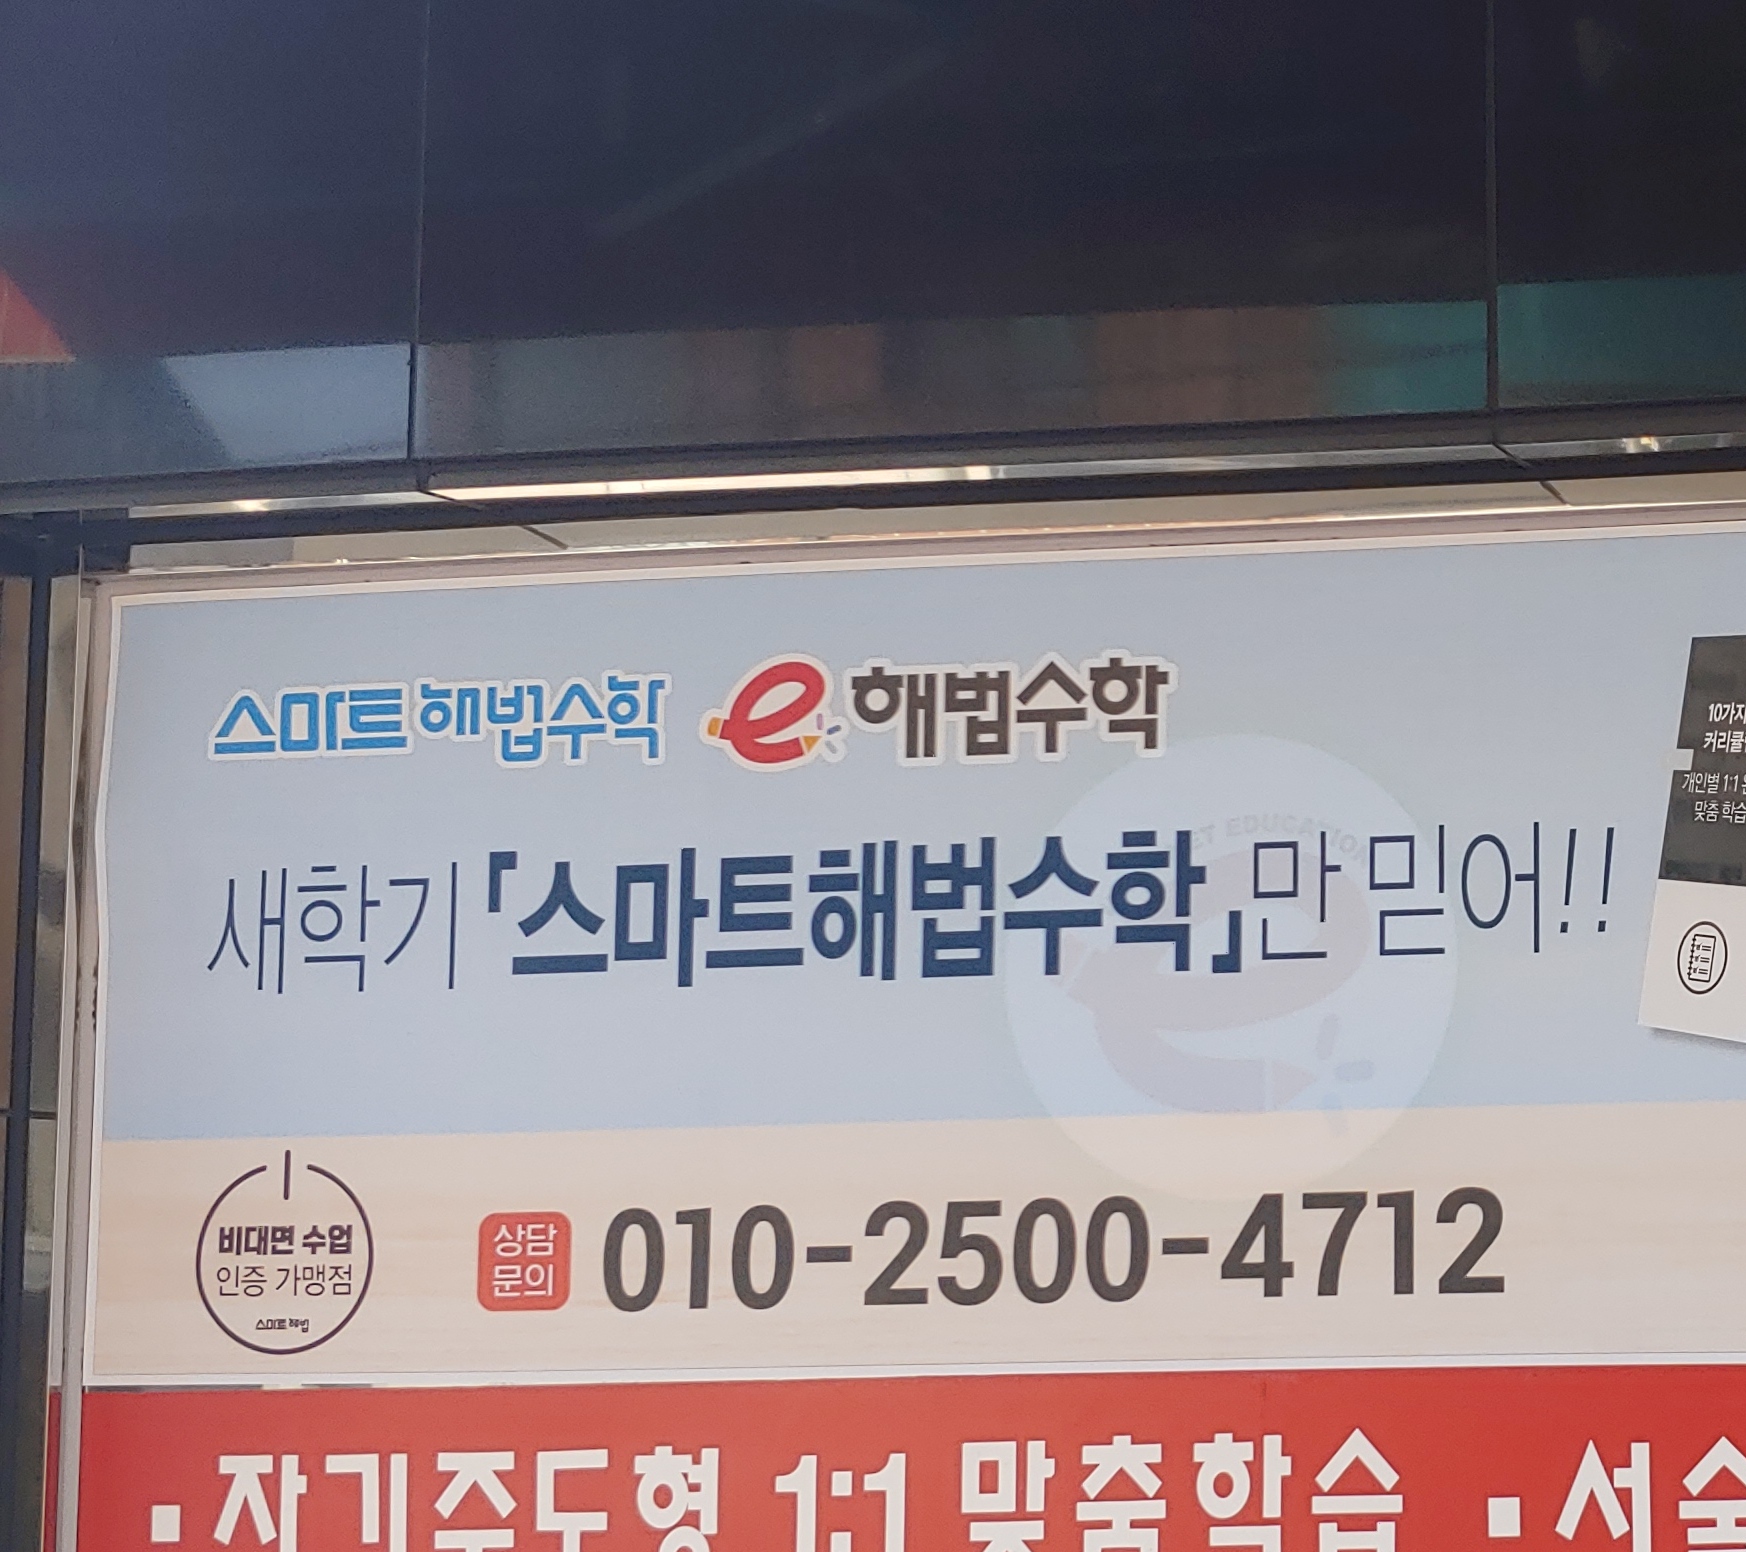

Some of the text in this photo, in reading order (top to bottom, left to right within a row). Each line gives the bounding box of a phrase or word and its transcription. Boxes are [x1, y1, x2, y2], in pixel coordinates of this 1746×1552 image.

[850, 656, 1169, 760] 해법수학
[1681, 772, 1720, 794] 개인별
[1694, 801, 1719, 822] 맞춤
[206, 861, 459, 995] 새학기
[1368, 822, 1615, 958] 믿어!!
[218, 1224, 353, 1256] 비대면 수업
[493, 1224, 557, 1258] 상담
[603, 1186, 1505, 1314] 010-2500-4712
[216, 1263, 352, 1297] 인증 가맹점
[492, 1263, 555, 1298] 문의
